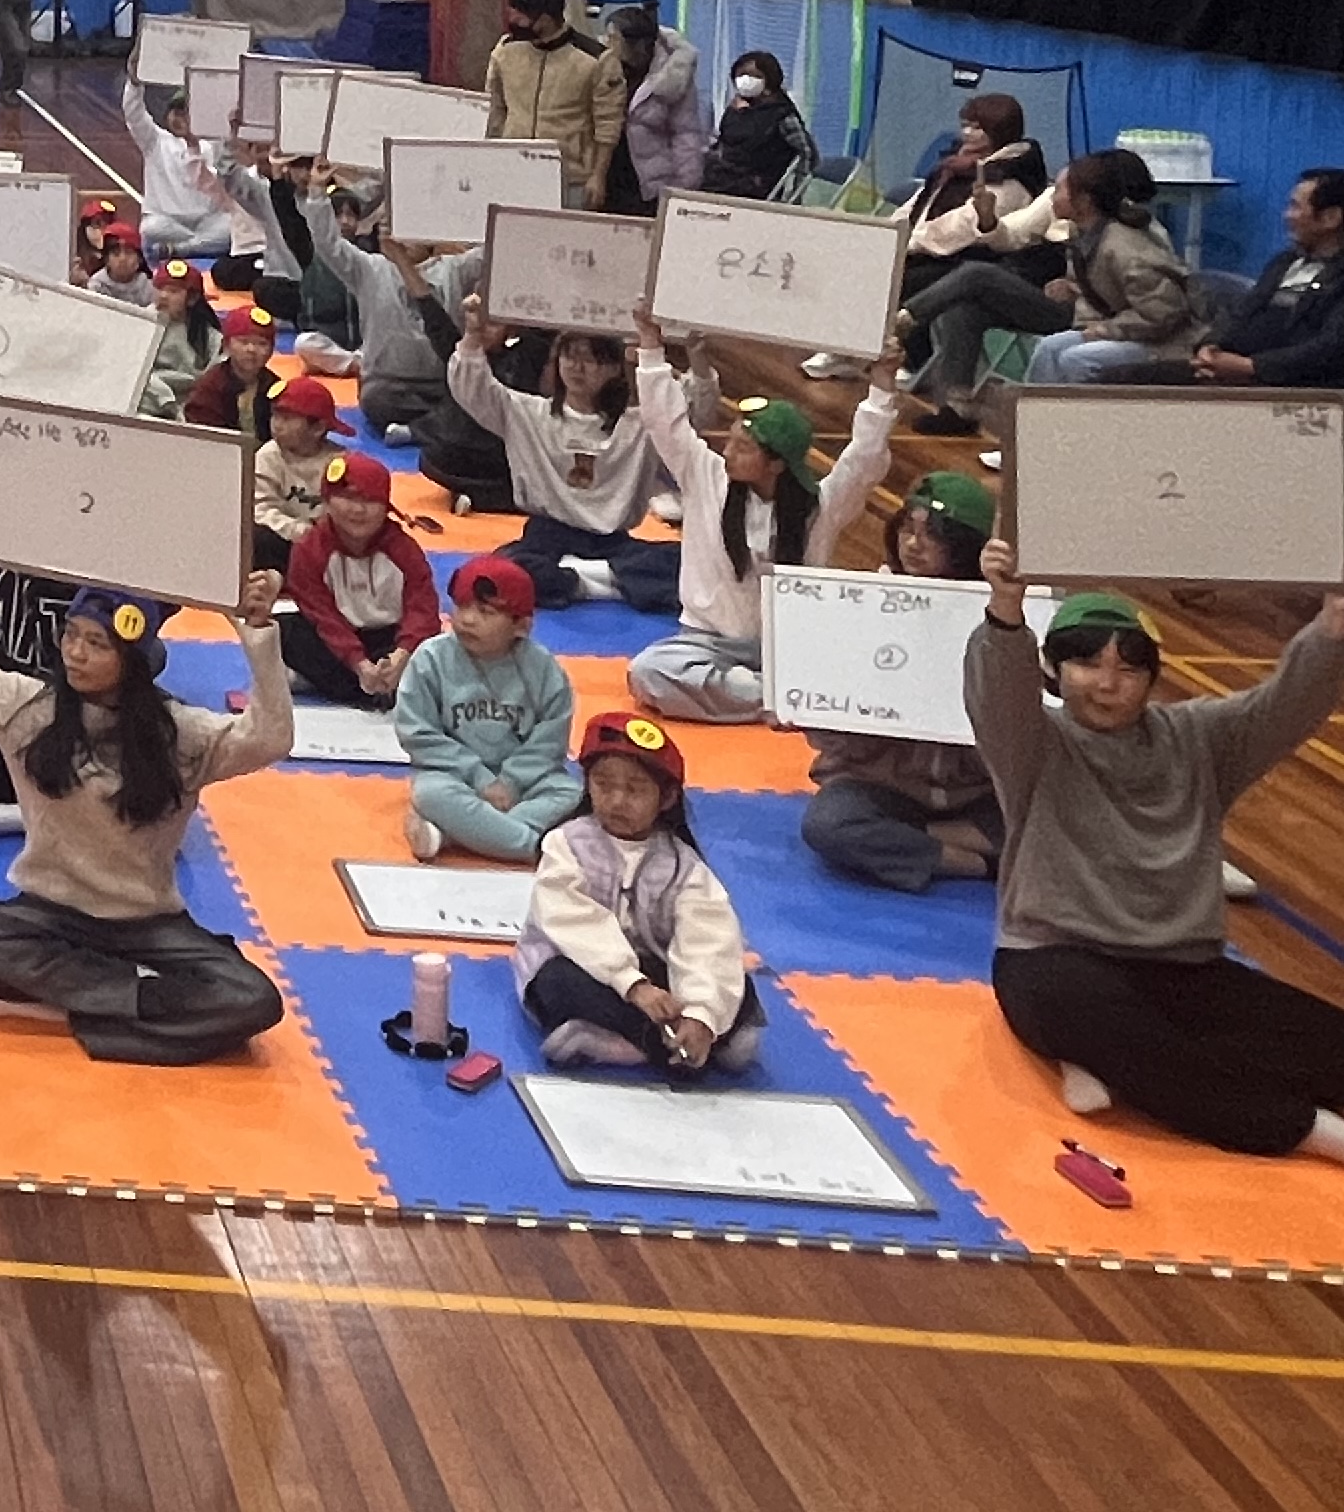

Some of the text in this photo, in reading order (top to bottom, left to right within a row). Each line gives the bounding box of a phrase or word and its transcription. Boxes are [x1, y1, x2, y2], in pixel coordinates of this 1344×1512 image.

[1156, 471, 1187, 500] 2
[78, 491, 96, 514] 2
[450, 696, 526, 733] FOREST
